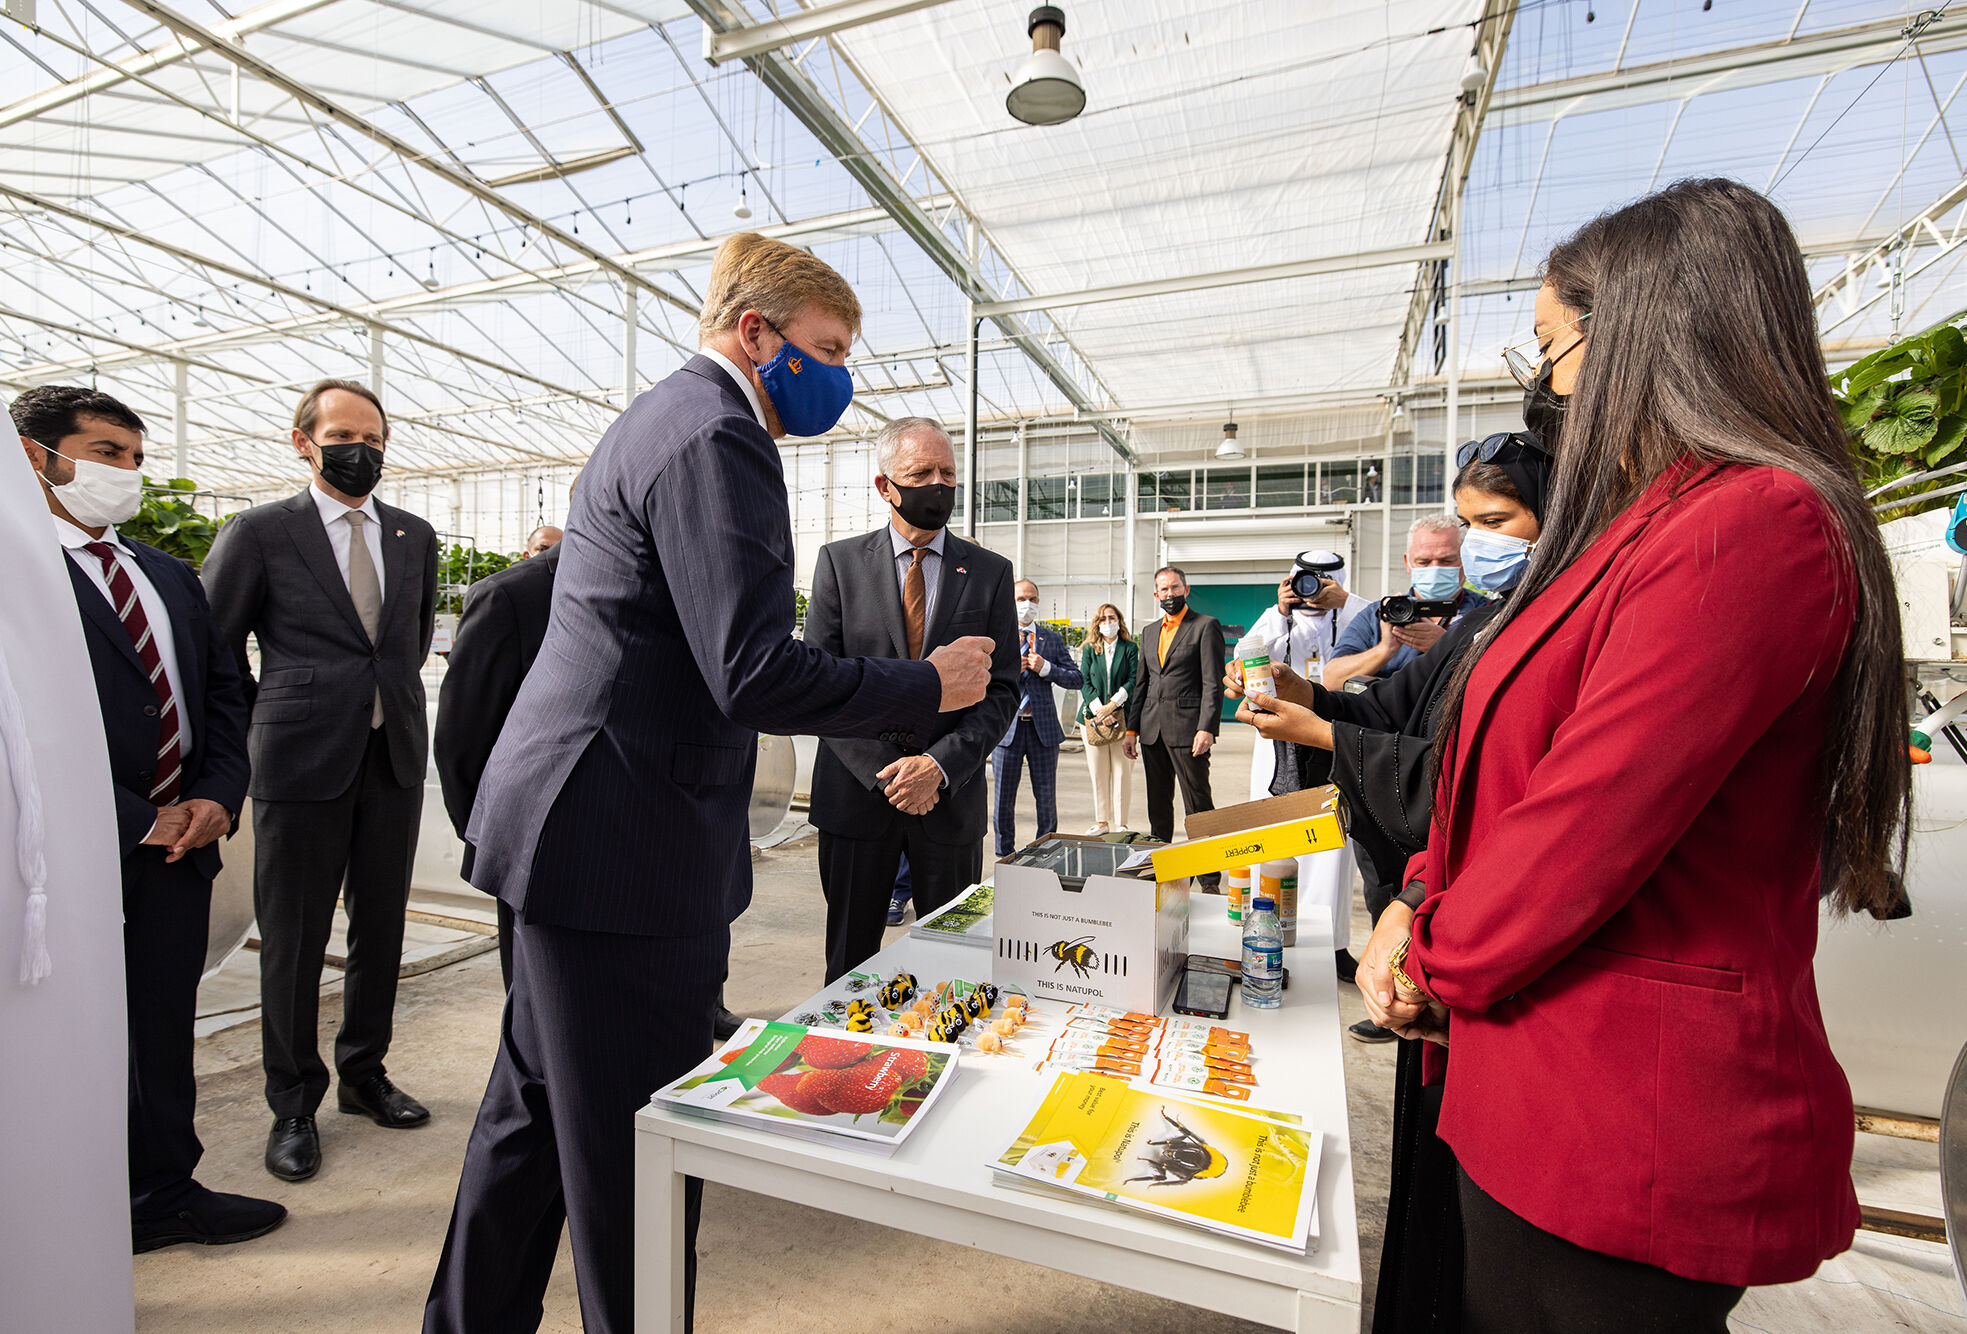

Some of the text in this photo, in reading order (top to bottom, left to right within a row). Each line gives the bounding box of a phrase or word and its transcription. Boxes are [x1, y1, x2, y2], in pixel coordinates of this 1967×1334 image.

[1080, 918, 1113, 927] BUMBLEBEE
[1037, 979, 1104, 998] THIS IS NATUPOL
[865, 1051, 900, 1090] Strawberry
[1127, 1121, 1140, 1133] This
[1256, 1135, 1268, 1147] This
[1113, 1138, 1131, 1163] Natupol
[1252, 1153, 1261, 1164] not
[1249, 1163, 1261, 1176] just
[1237, 1180, 1256, 1213] bumblebee
